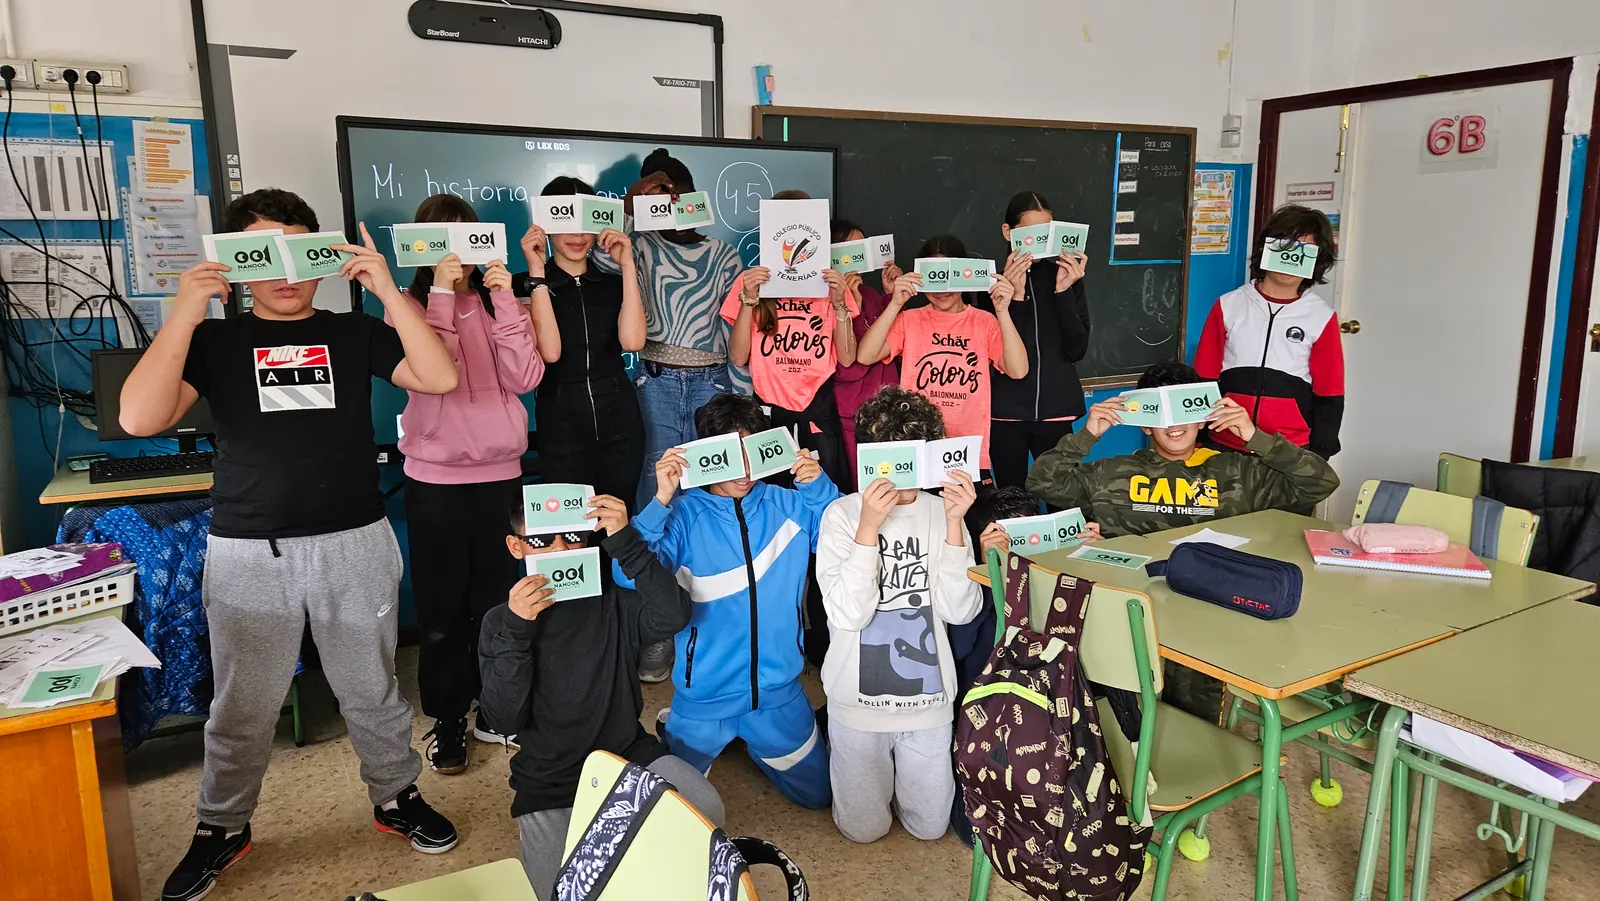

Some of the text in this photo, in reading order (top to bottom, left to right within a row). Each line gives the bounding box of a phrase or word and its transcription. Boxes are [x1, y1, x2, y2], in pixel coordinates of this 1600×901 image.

[427, 28, 460, 38] StarBoard
[518, 36, 549, 45] HITACHI
[537, 142, 570, 151] L8X BDS
[372, 163, 529, 203] Mi historia
[724, 180, 762, 215] 45
[772, 223, 822, 242] COLEGIO PÚBLICO
[237, 262, 267, 270] NANOOK
[310, 258, 337, 267] NANOOK
[776, 270, 818, 282] TENERÍAS
[775, 298, 814, 314] Schär
[760, 325, 830, 359] Colores
[931, 333, 971, 350] Schär
[266, 346, 310, 363] NIKE
[776, 357, 812, 367] BALONMANO
[265, 369, 325, 384] AIR
[916, 359, 982, 393] Colores
[929, 390, 968, 400] BALONMANO
[702, 465, 725, 474] NANOOK
[1129, 475, 1219, 507] GAME
[1155, 505, 1194, 515] FOR THE
[554, 580, 580, 588] NANOOK
[895, 700, 919, 708] WITH
[1082, 819, 1103, 838] GOOD
